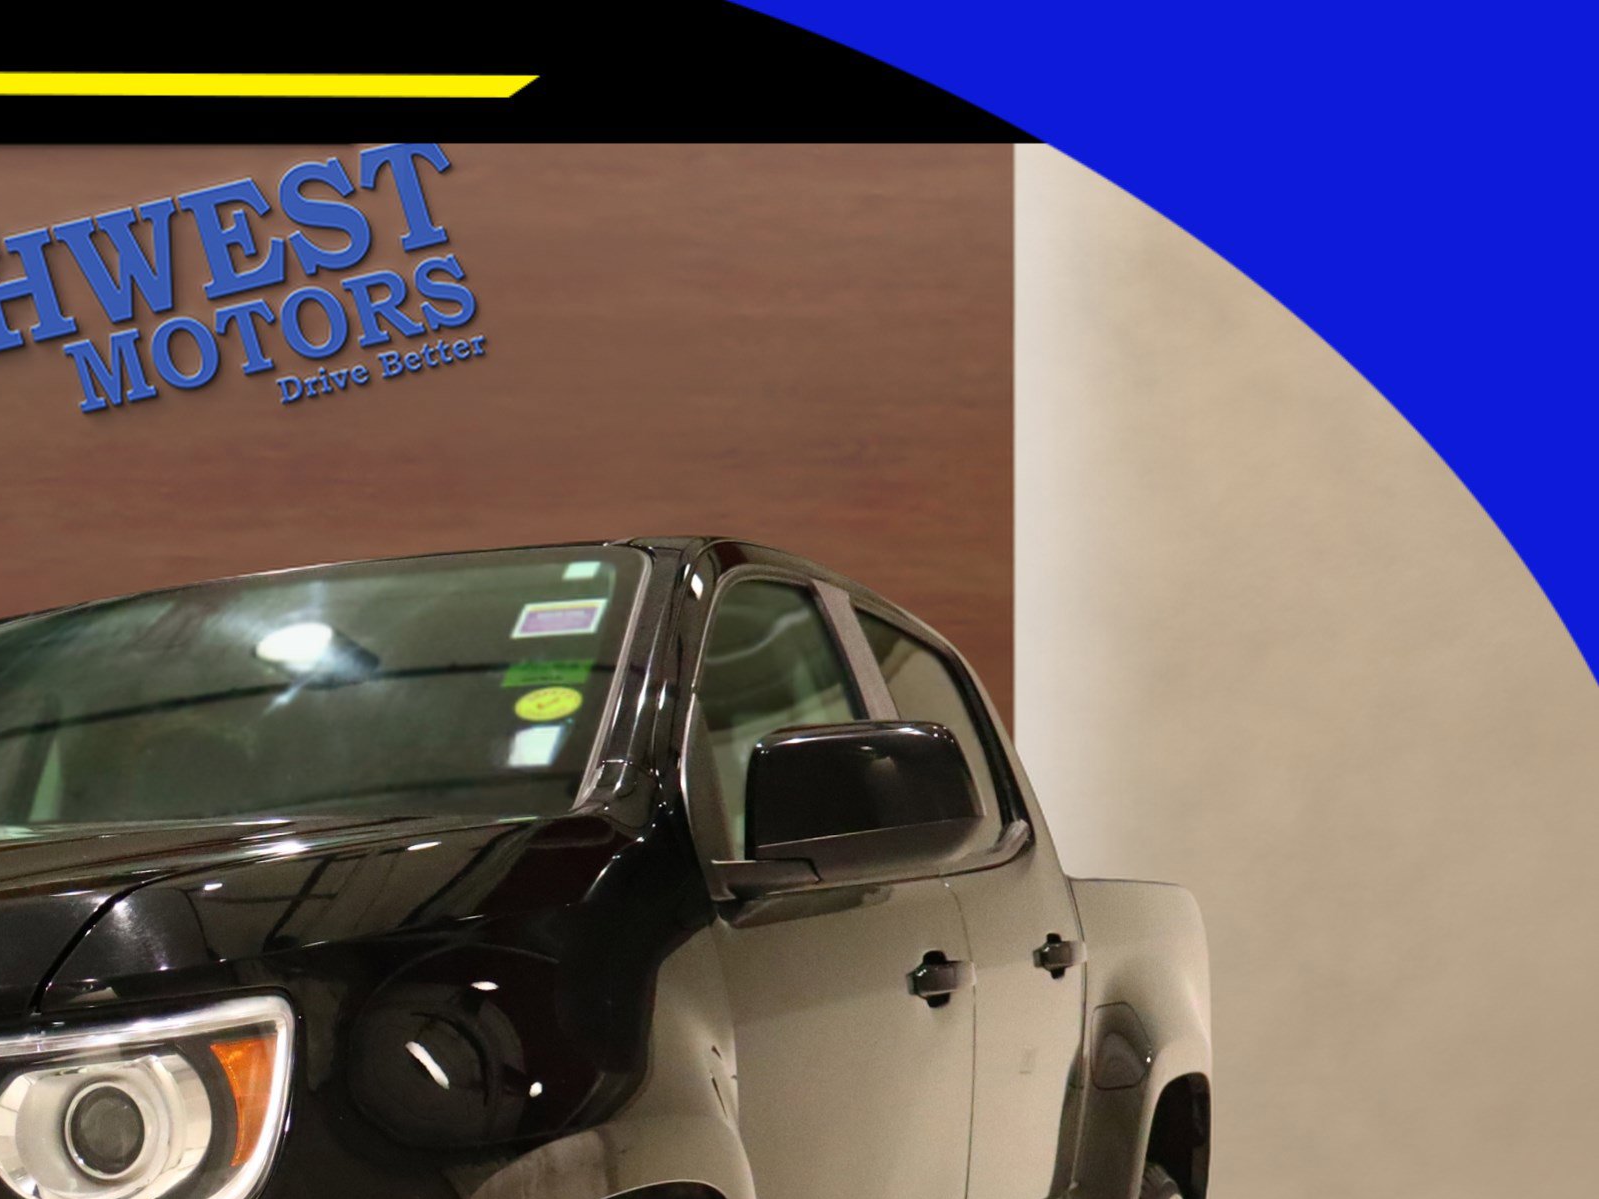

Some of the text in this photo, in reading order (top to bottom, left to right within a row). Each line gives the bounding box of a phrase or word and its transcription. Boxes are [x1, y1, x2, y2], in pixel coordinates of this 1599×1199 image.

[63, 253, 478, 413] MOTORS
[277, 331, 487, 404] Drive Better
